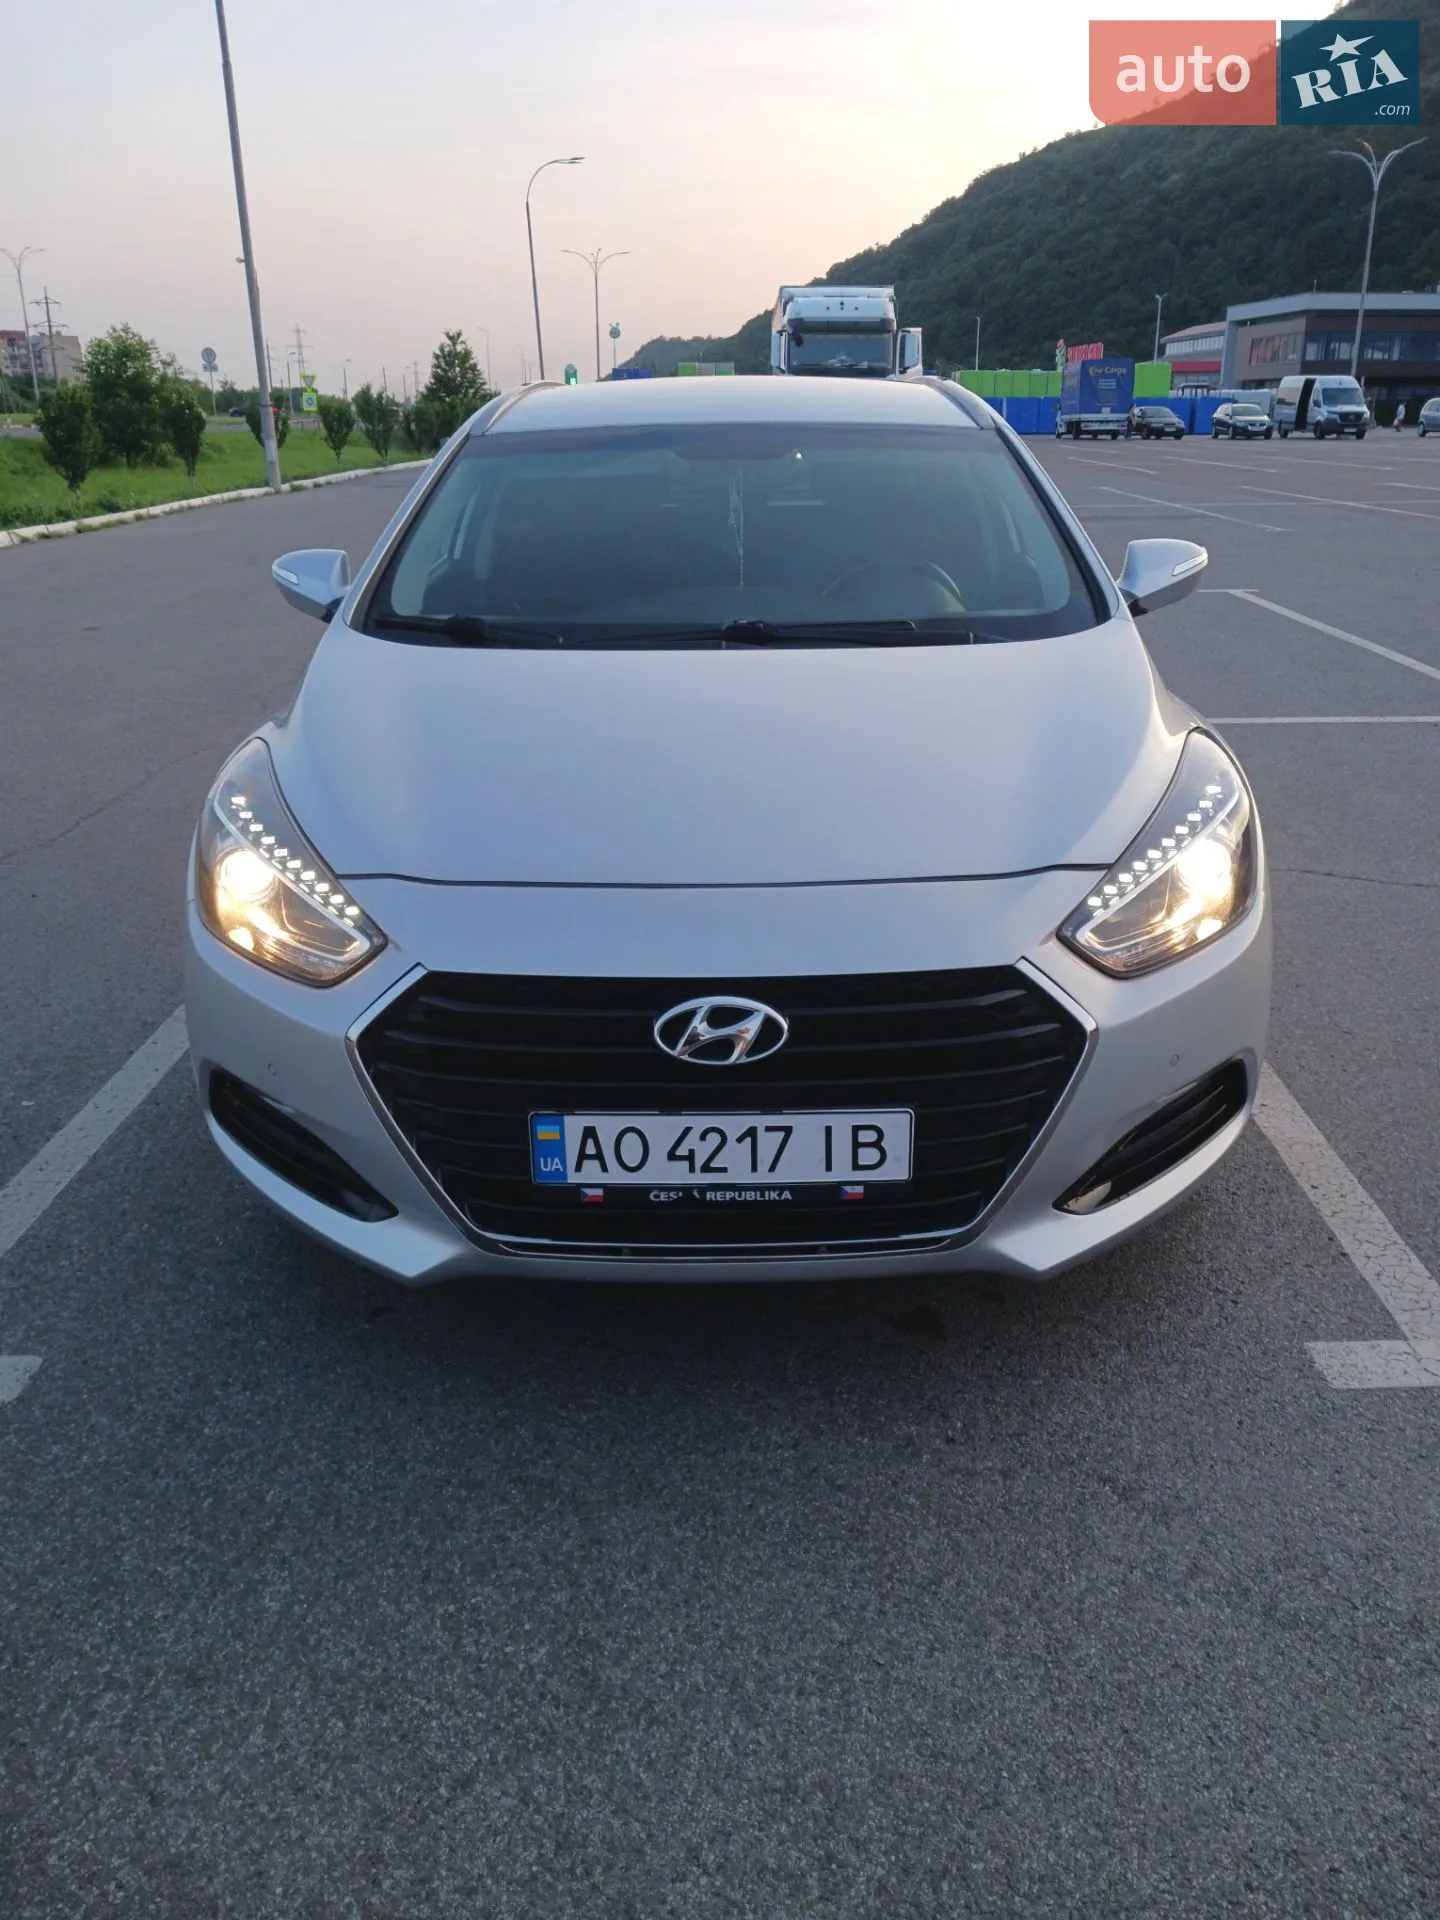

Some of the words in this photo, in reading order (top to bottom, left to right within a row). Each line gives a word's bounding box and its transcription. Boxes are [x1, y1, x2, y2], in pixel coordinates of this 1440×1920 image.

[574, 1125, 650, 1173] AO
[666, 1125, 794, 1174] 4217
[824, 1124, 888, 1172] IB
[540, 1157, 564, 1172] UA
[705, 1190, 793, 1201] REPUBLIKA
